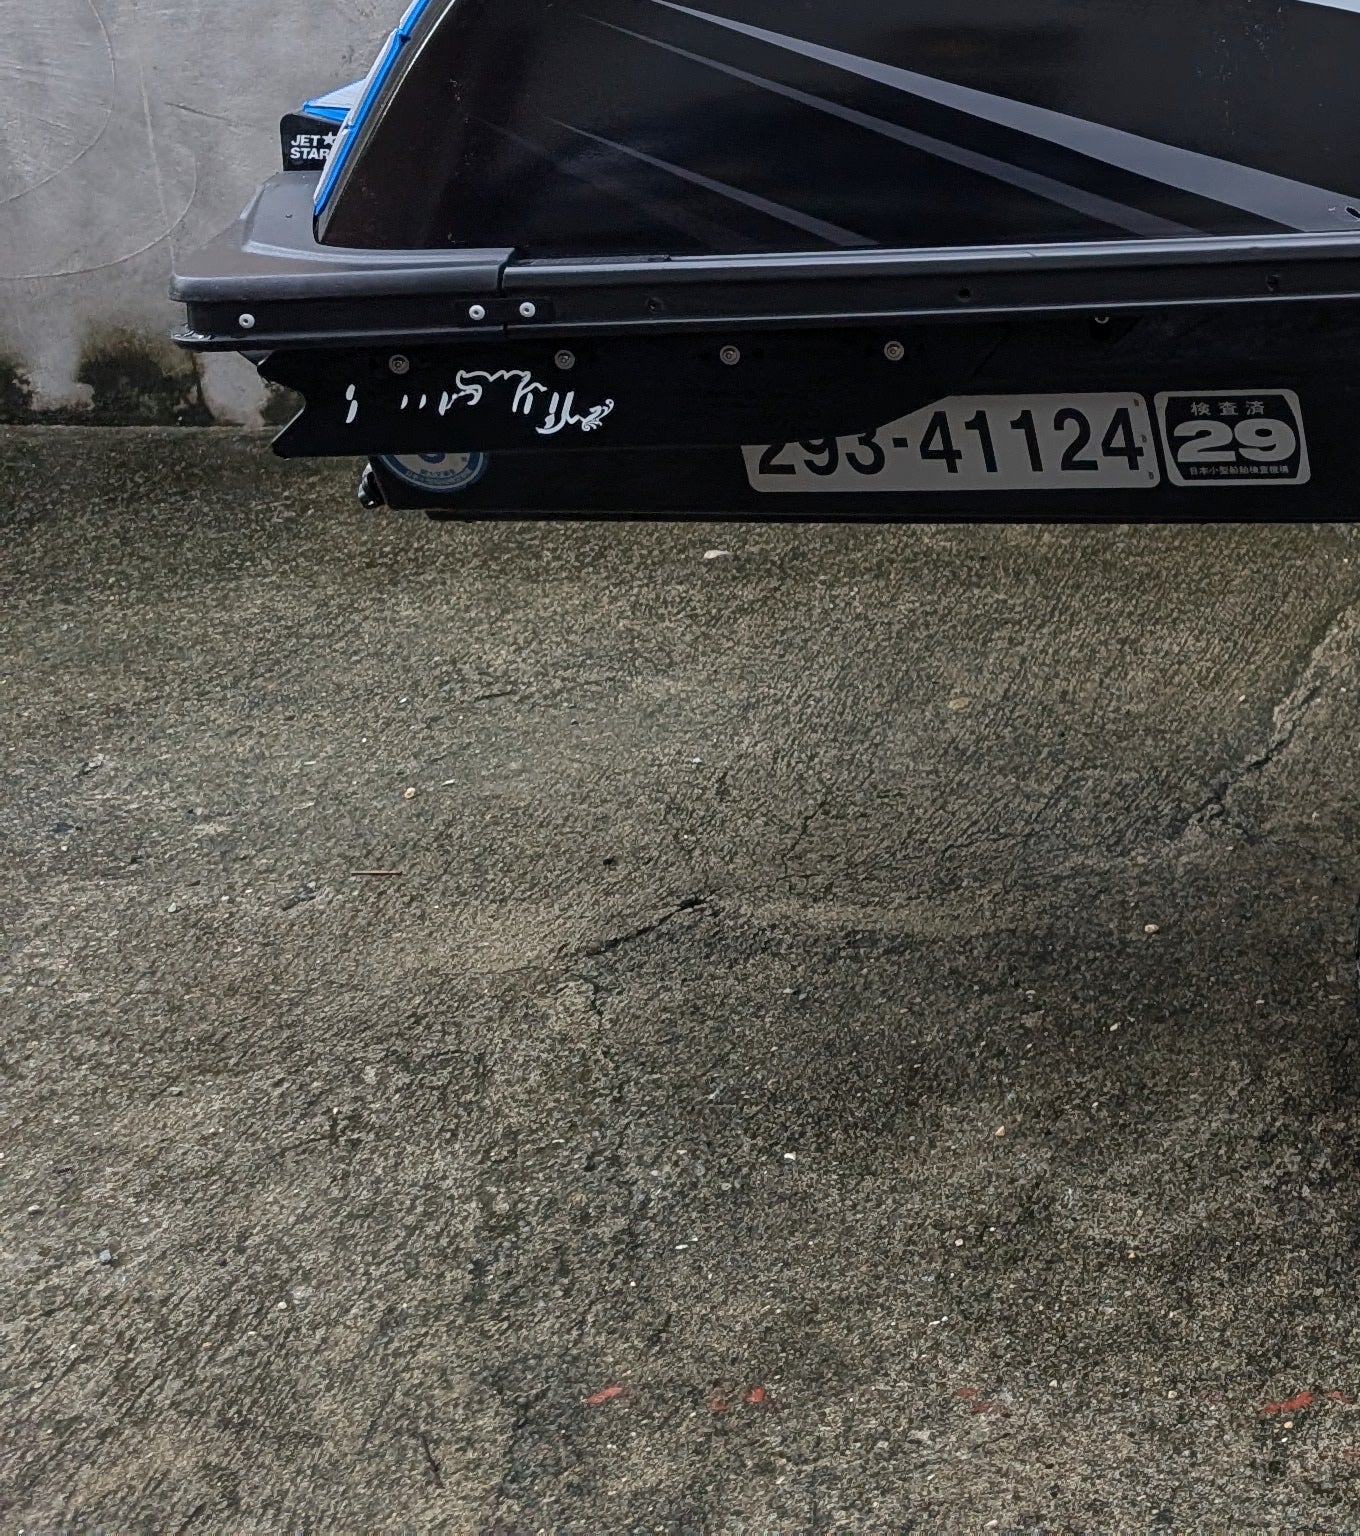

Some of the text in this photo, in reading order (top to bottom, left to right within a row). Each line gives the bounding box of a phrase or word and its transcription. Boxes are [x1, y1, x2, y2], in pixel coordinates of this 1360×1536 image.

[291, 134, 321, 146] JET
[290, 147, 330, 159] STAR
[1190, 400, 1265, 416] 検査済
[758, 407, 1145, 476] 293-41124
[1173, 417, 1297, 463] 29
